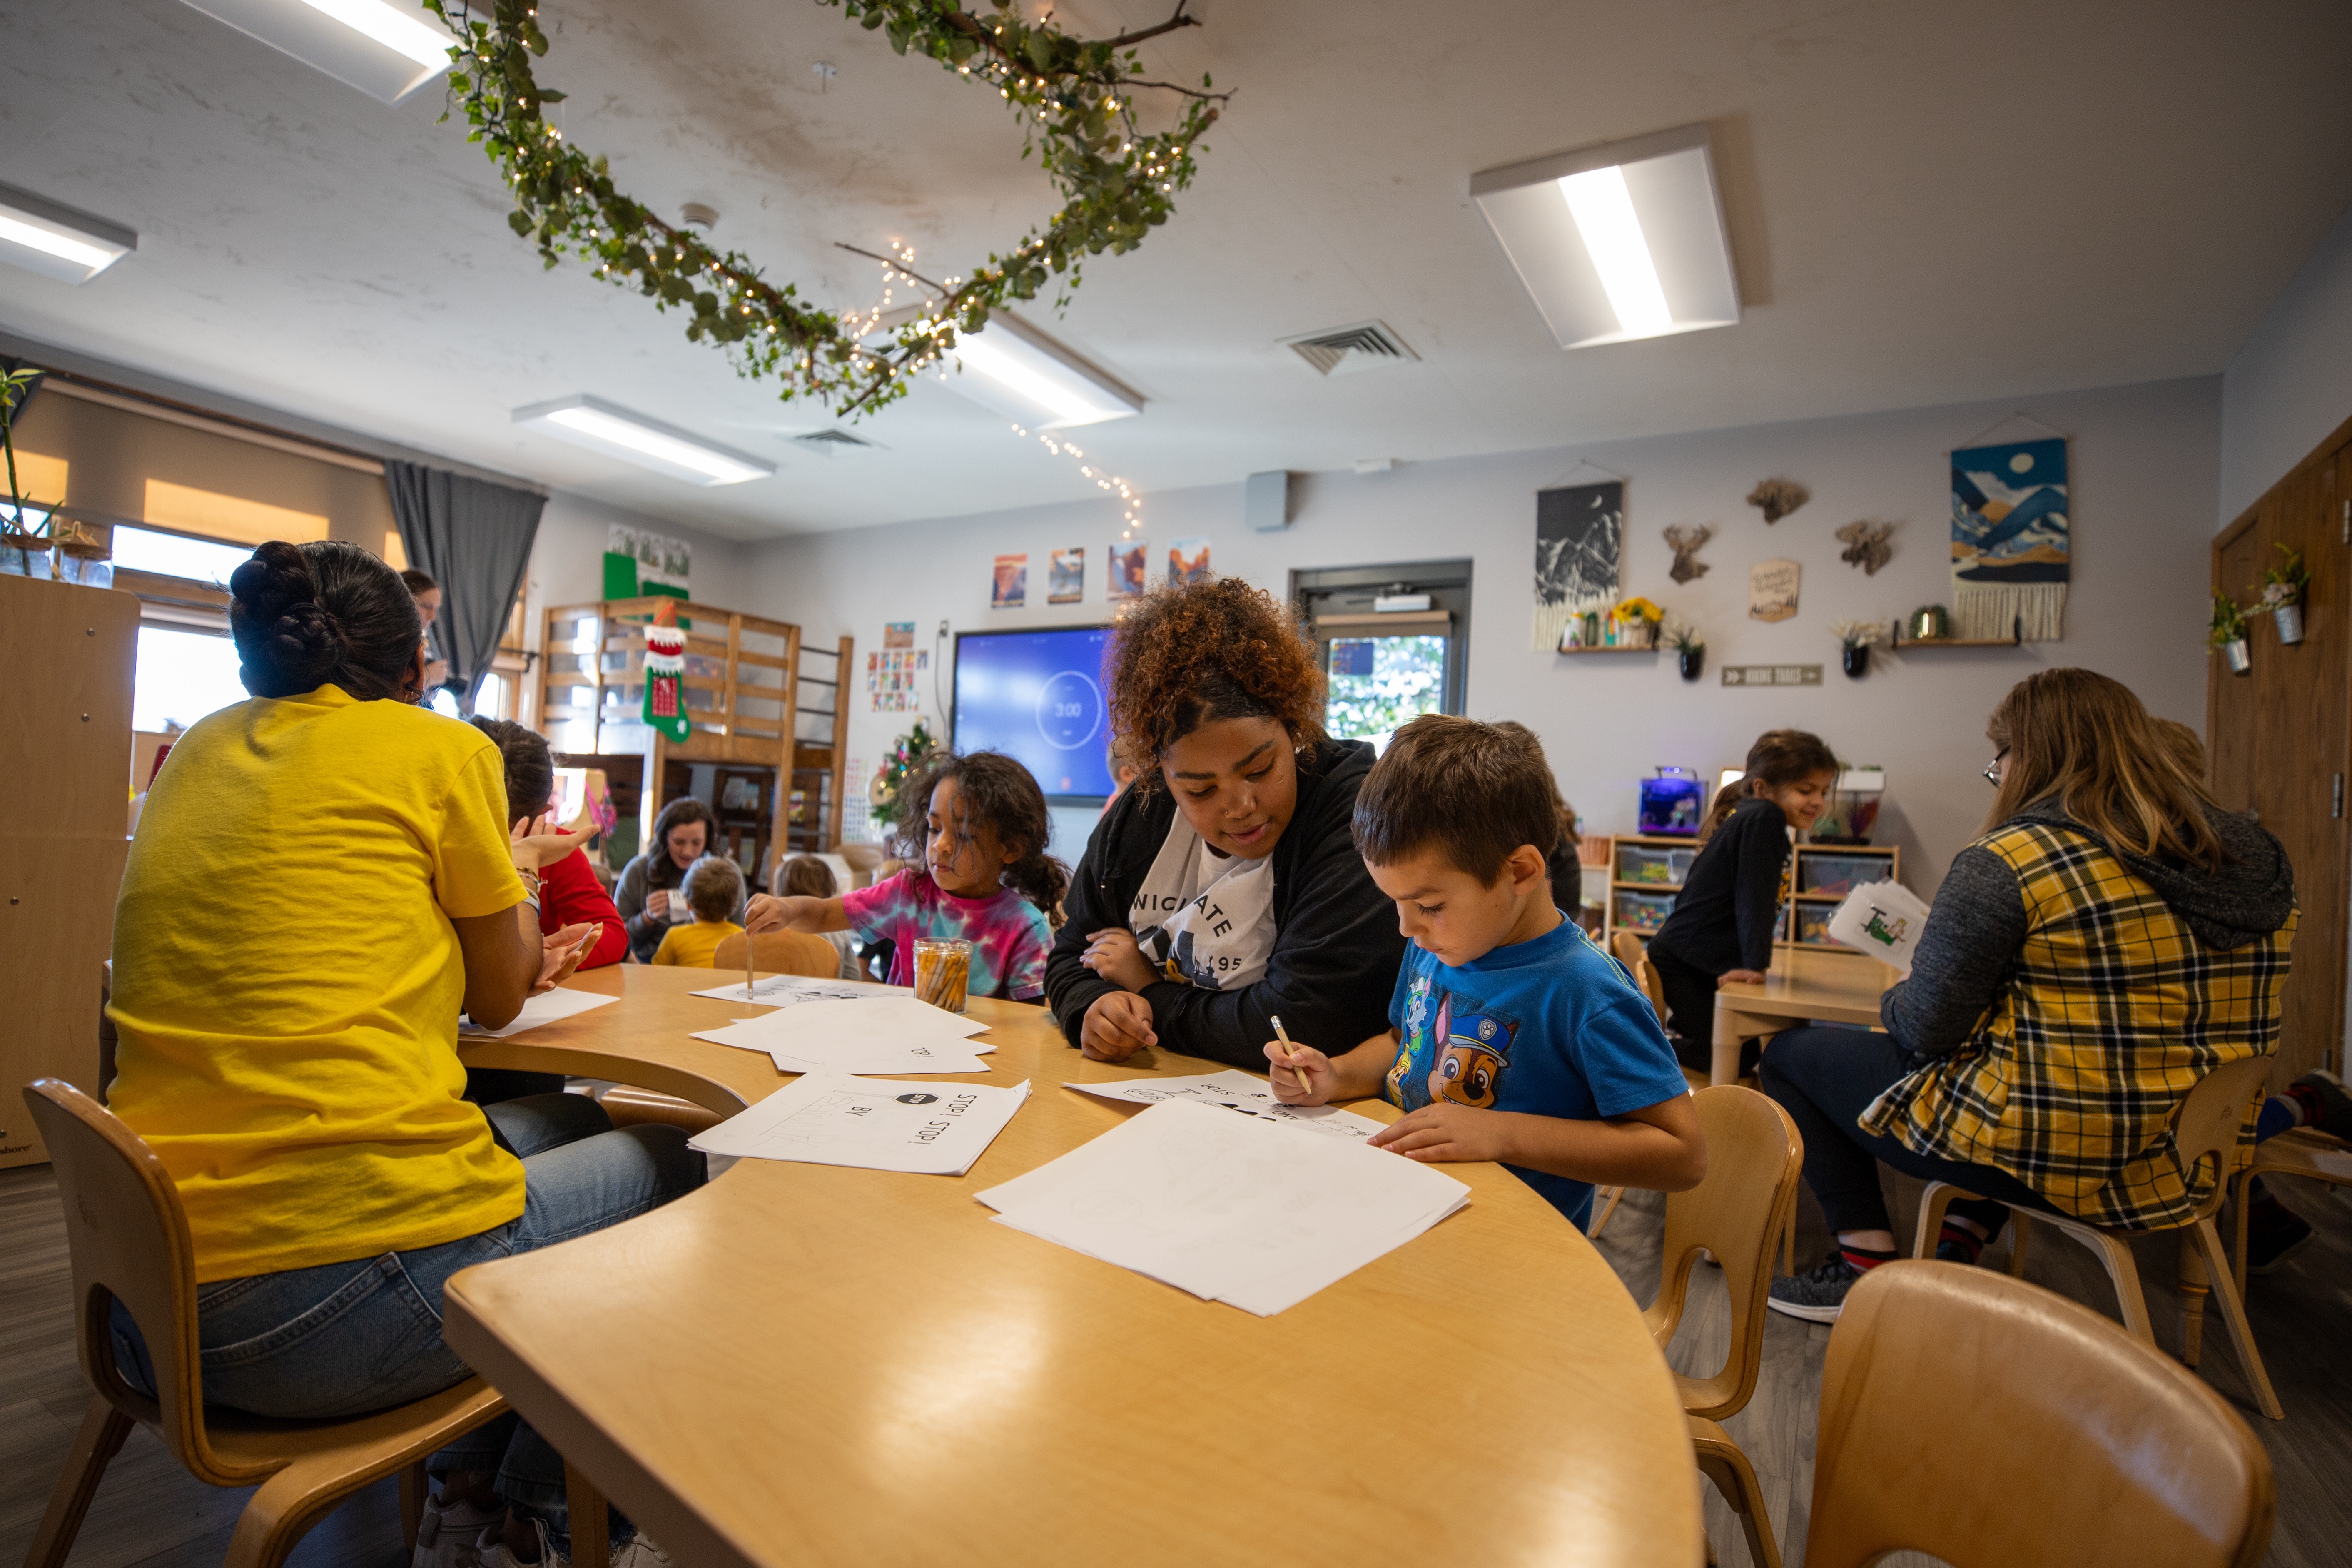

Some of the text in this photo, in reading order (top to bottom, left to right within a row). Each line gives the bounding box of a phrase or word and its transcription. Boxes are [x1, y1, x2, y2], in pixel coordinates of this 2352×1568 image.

[911, 1047, 935, 1058] OP!
[908, 1094, 927, 1104] STOP
[1131, 1090, 1166, 1100] STOP
[845, 1107, 873, 1117] BY
[1271, 1110, 1303, 1120] AND
[907, 1094, 977, 1145] STOP! STOP!
